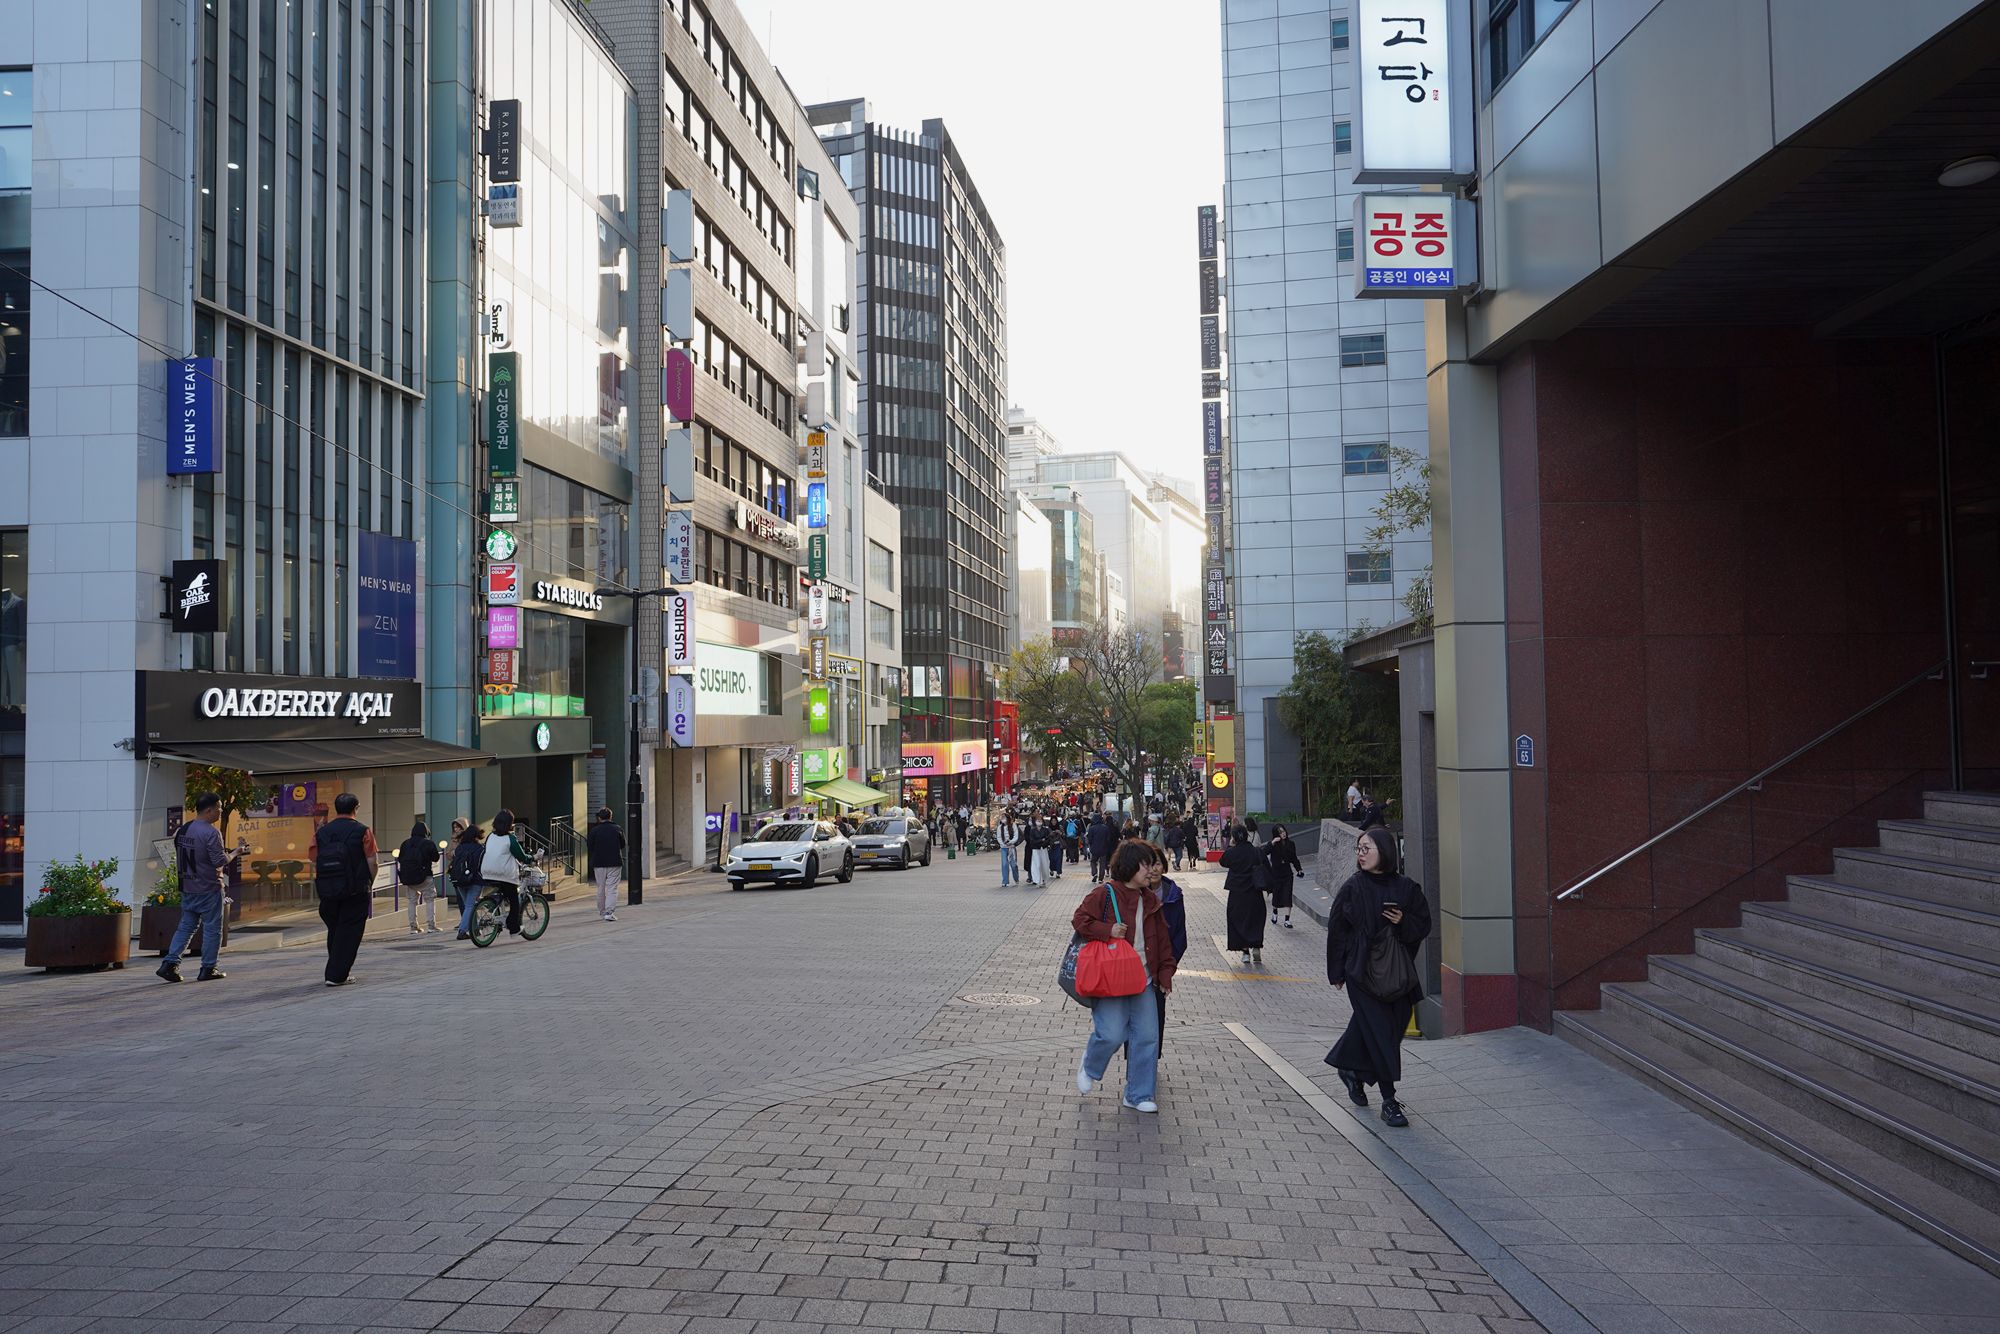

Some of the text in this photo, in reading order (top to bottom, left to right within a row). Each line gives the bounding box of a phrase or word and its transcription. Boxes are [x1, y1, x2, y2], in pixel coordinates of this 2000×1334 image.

[1369, 212, 1448, 257] 공증
[1369, 270, 1451, 284] 공증인 이승식
[184, 363, 196, 455] MEN'S WEAR
[811, 446, 823, 471] 치과
[669, 537, 680, 565] 치과
[185, 586, 205, 598] OAK
[360, 575, 412, 595] MEN'S WEAR
[537, 580, 603, 611] STARBUCKS
[180, 592, 211, 607] BERRY
[374, 615, 398, 631] ZEN
[674, 596, 685, 661] SUSHIRO
[494, 662, 507, 671] 50
[699, 667, 746, 695] SUSHIRO
[201, 687, 343, 719] OAKBERRY
[674, 713, 686, 735] CU
[1521, 751, 1529, 762] 65
[266, 818, 295, 830] COFFEE
